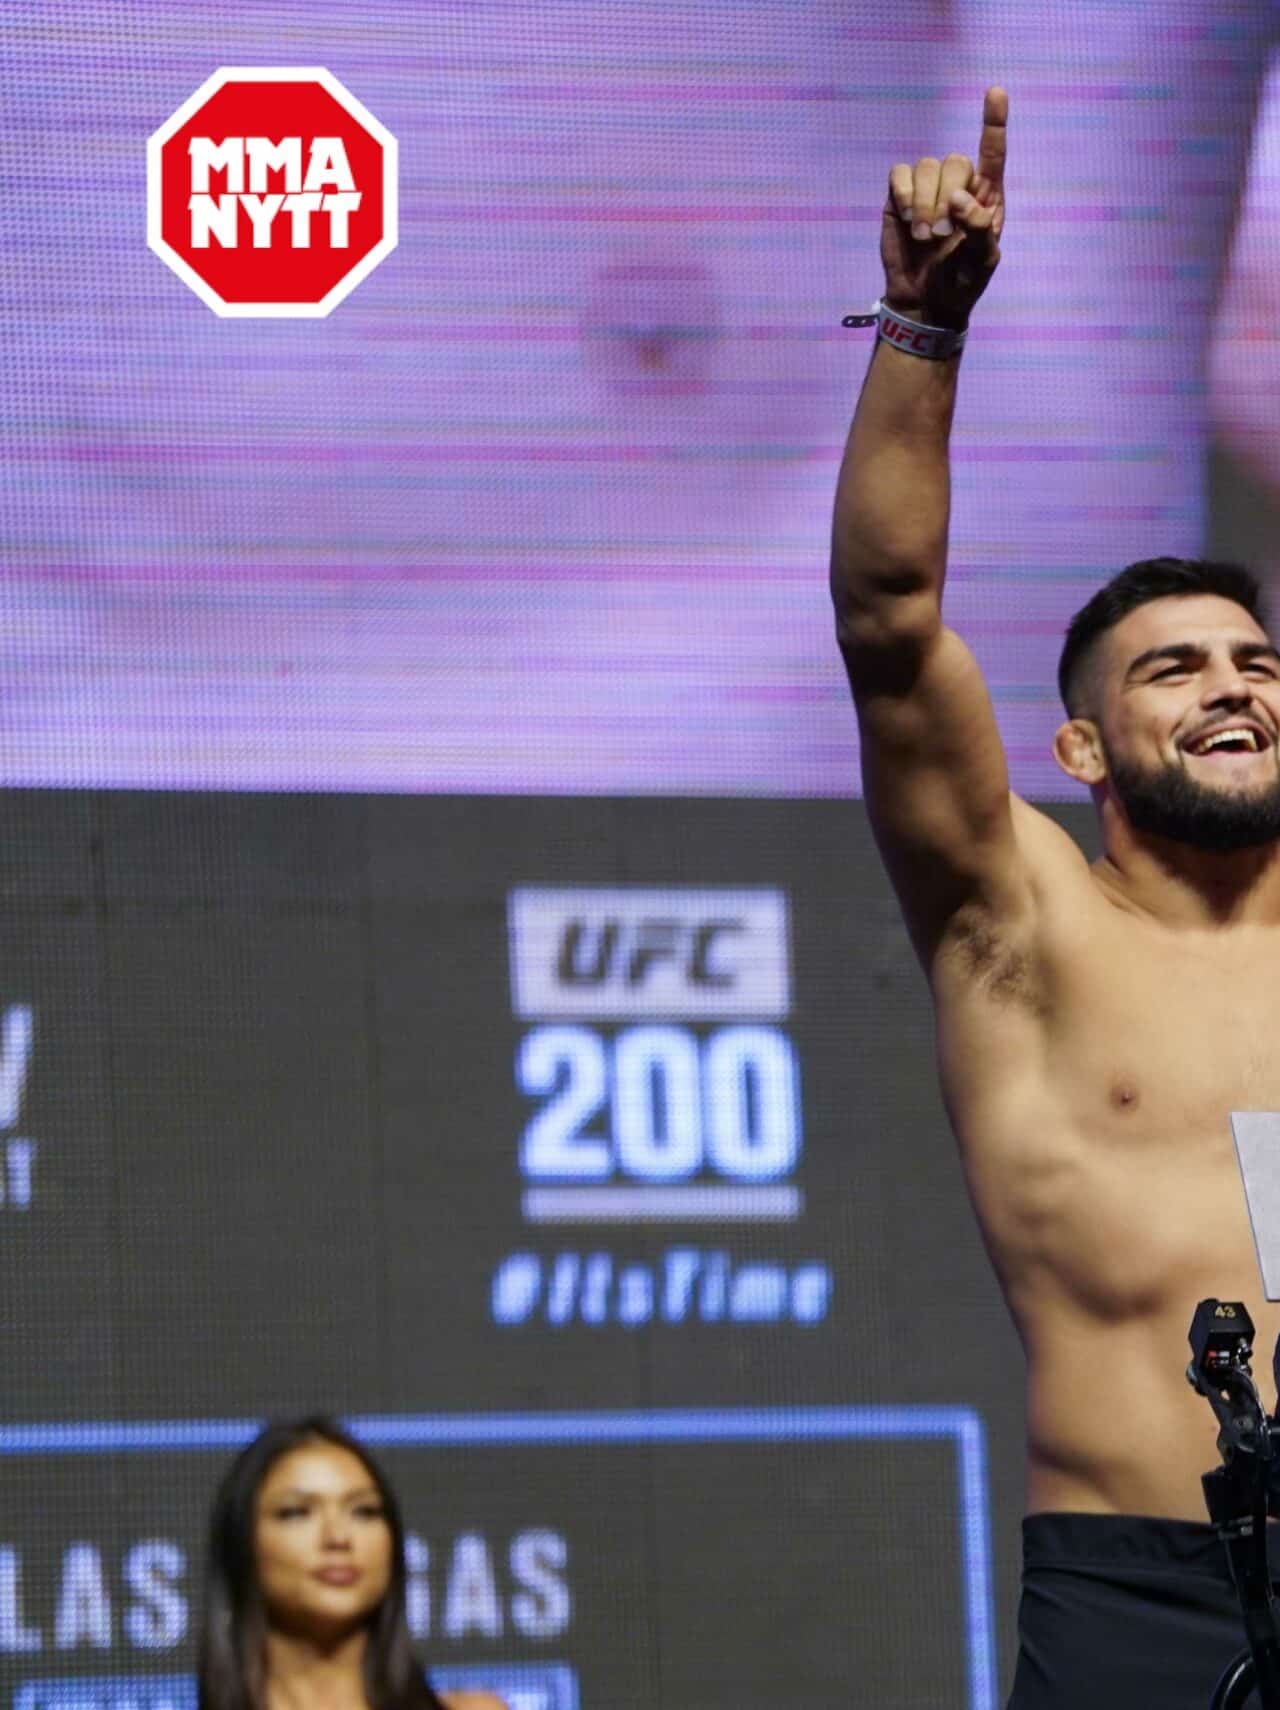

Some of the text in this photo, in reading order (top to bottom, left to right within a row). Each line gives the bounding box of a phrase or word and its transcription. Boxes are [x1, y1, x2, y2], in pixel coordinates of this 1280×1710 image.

[881, 316, 929, 352] UFC
[557, 916, 747, 988] UFC
[515, 1023, 802, 1182] 200
[1215, 1305, 1236, 1318] 43
